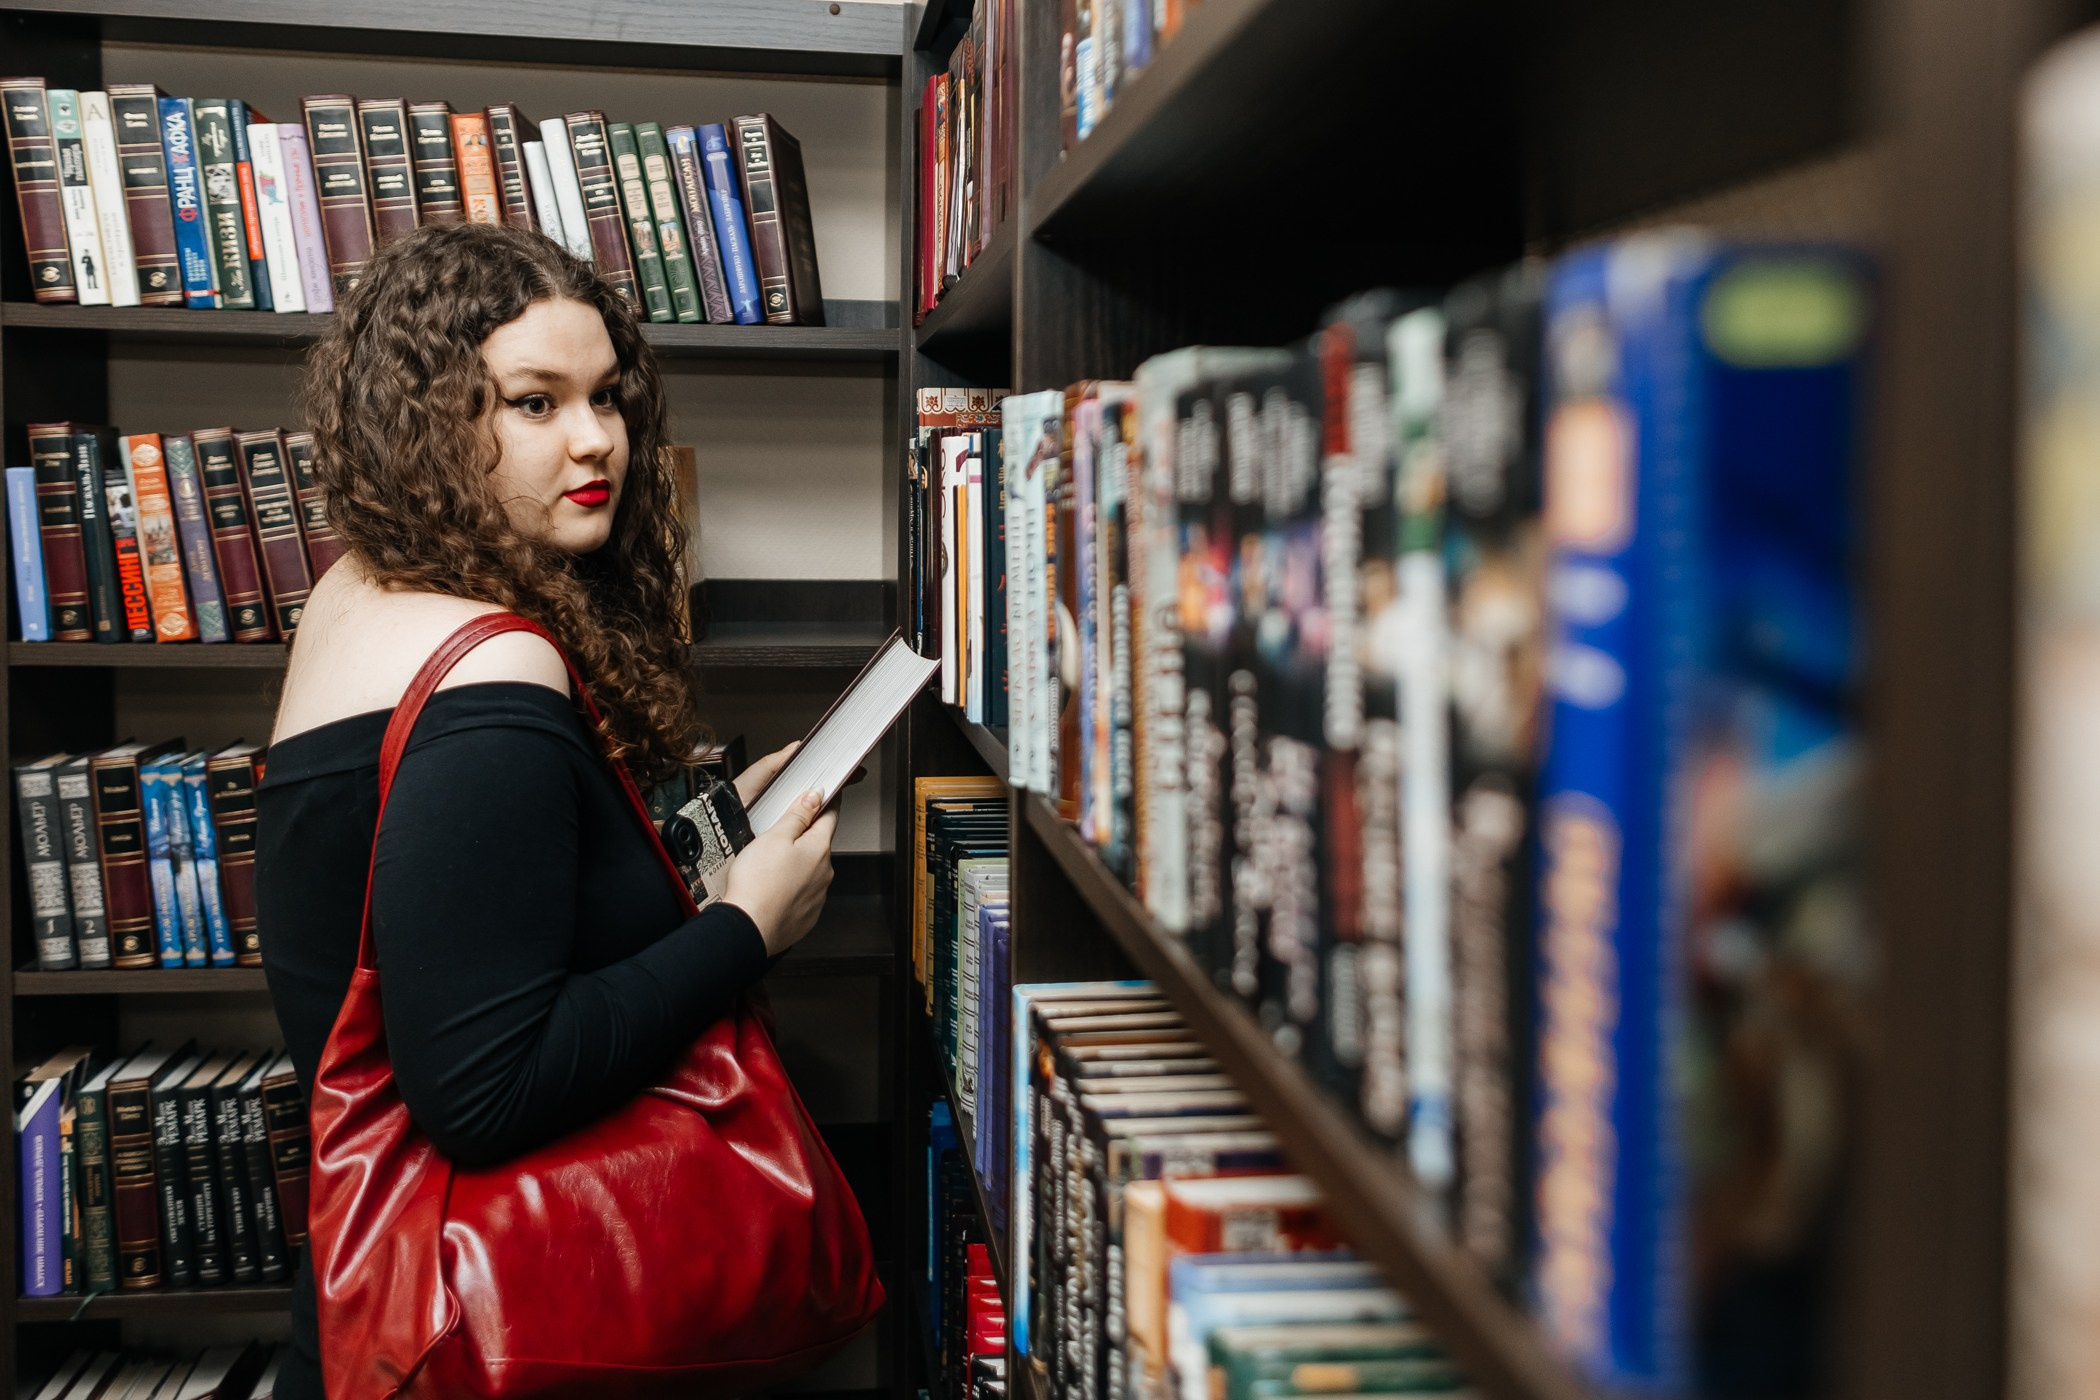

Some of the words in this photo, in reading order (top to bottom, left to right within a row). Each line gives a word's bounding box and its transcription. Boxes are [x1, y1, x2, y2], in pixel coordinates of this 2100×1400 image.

[165, 111, 190, 164] КАФКА
[173, 165, 199, 222] ФРАНЦ
[680, 158, 701, 213] МОПАССАН
[217, 211, 242, 268] КИЗИ
[728, 223, 741, 253] ПАСКАЛЬ
[81, 473, 96, 519] Паскаль
[115, 537, 151, 630] ЛЕССИНГ
[1010, 514, 1023, 620] ВРЕМЕНИ
[1011, 628, 1025, 728] ЗЕРКАЛО
[31, 801, 53, 858] МОЛЬЕР
[69, 802, 89, 859] МОЛЬЕР
[47, 918, 55, 935] 1
[84, 919, 96, 935] 2
